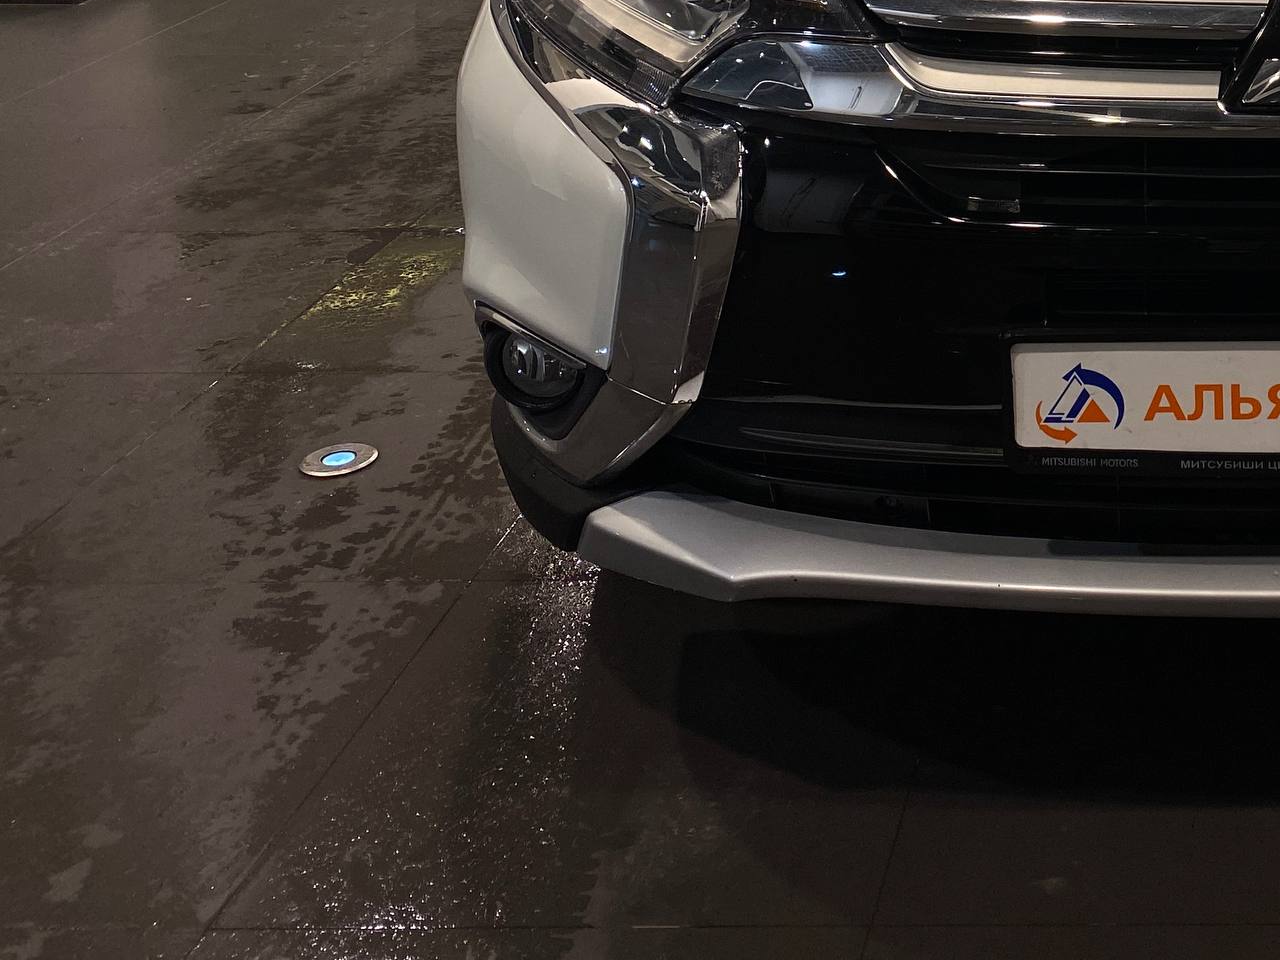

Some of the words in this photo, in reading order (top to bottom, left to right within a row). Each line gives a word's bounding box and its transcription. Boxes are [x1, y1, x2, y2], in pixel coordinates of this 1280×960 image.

[1041, 456, 1097, 467] MITSUBISHI
[1100, 458, 1139, 468] MOTORS
[1180, 459, 1264, 470] МИТСУБИШИ
